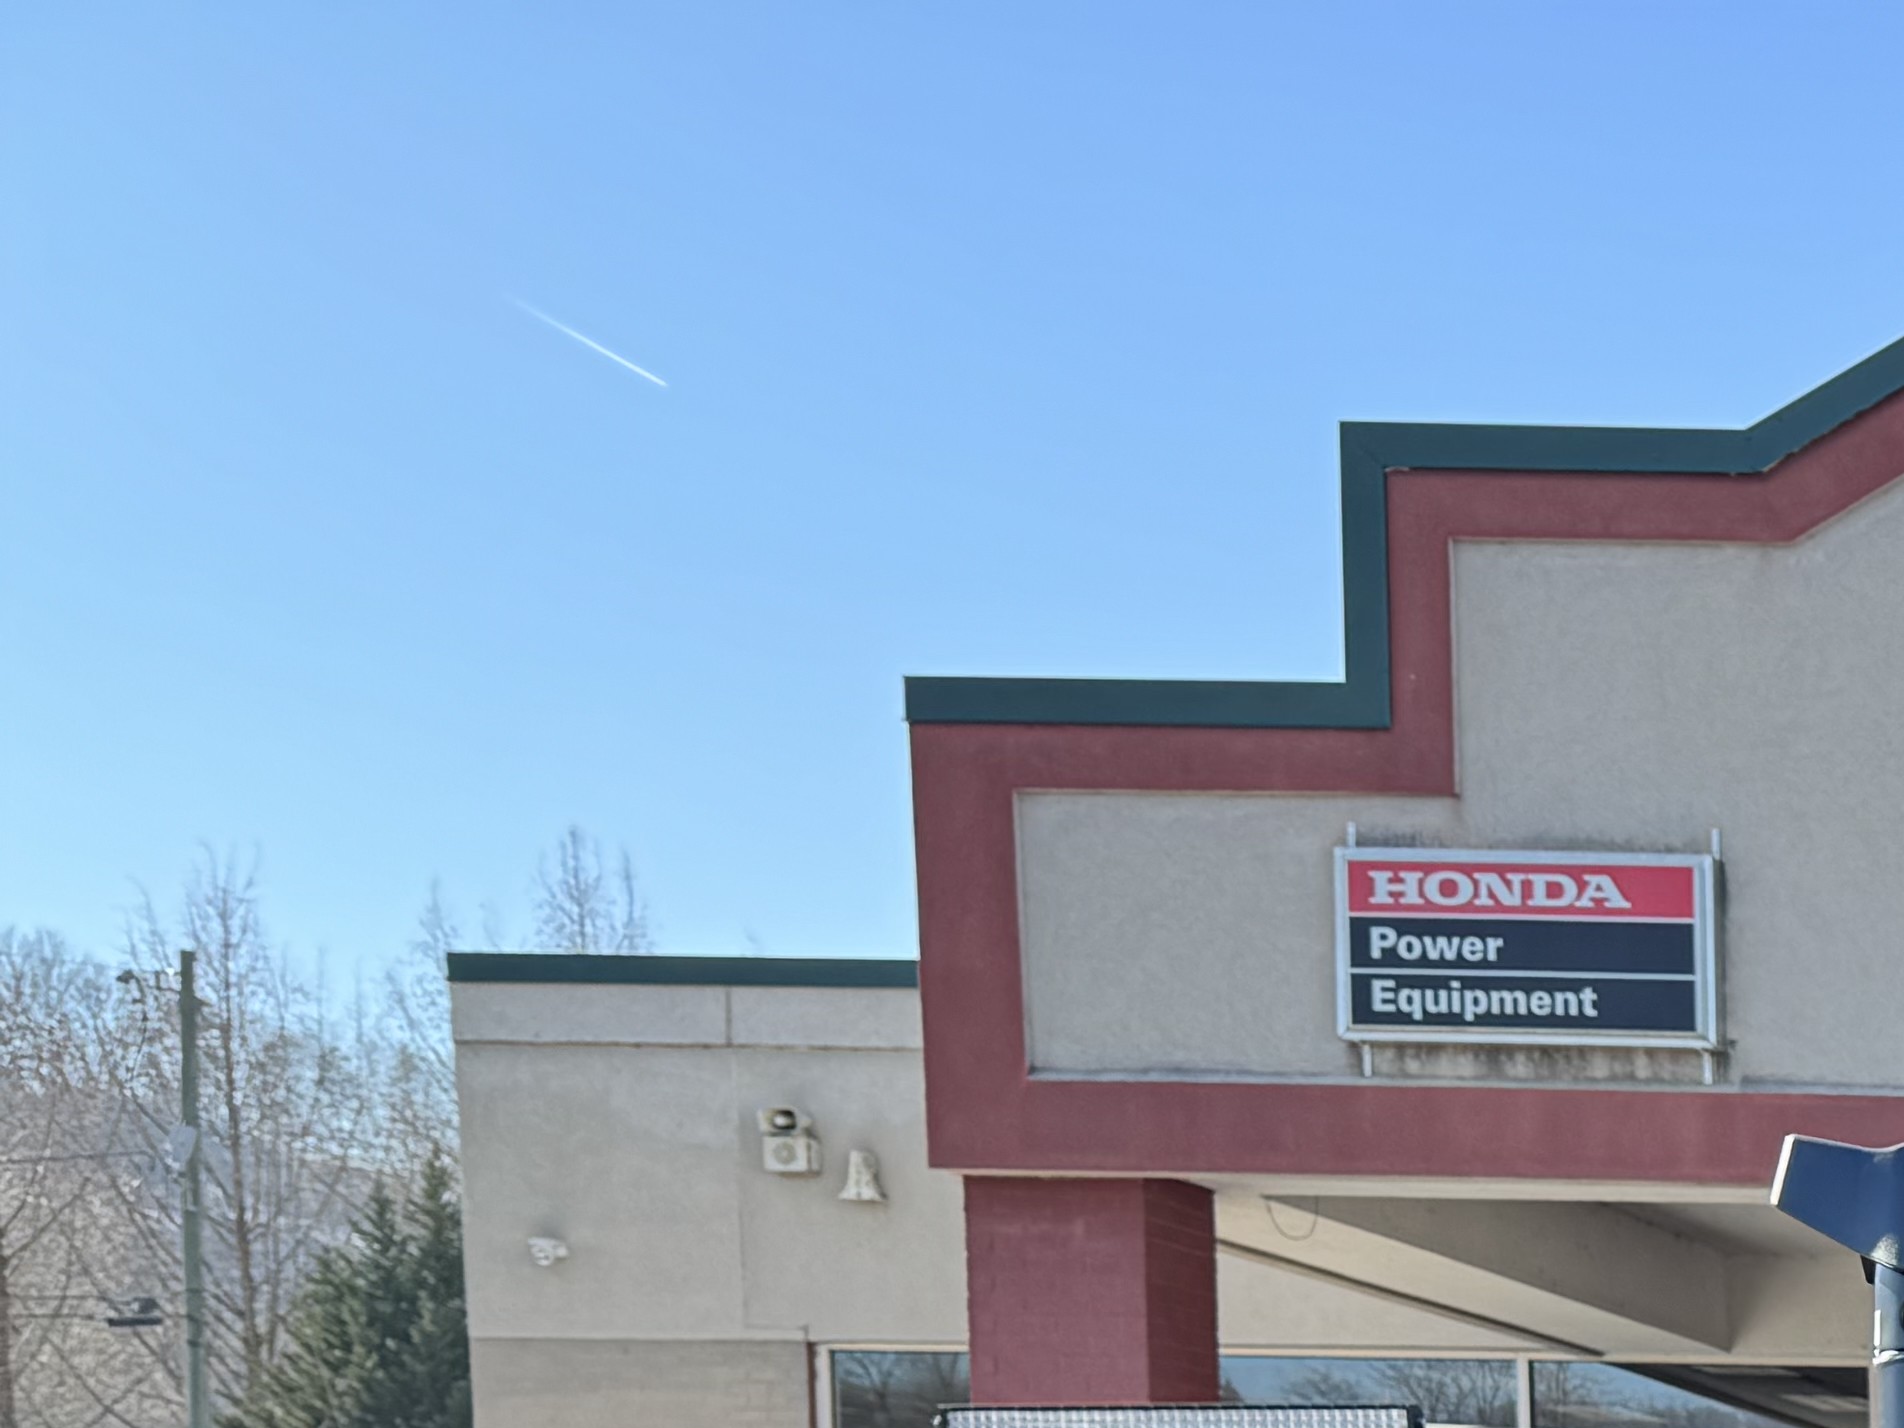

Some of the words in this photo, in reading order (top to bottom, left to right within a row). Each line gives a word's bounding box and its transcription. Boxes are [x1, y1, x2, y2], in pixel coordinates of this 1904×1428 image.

[1368, 869, 1632, 909] HONDA
[1369, 925, 1504, 962] Power
[1371, 978, 1600, 1022] Equipment
